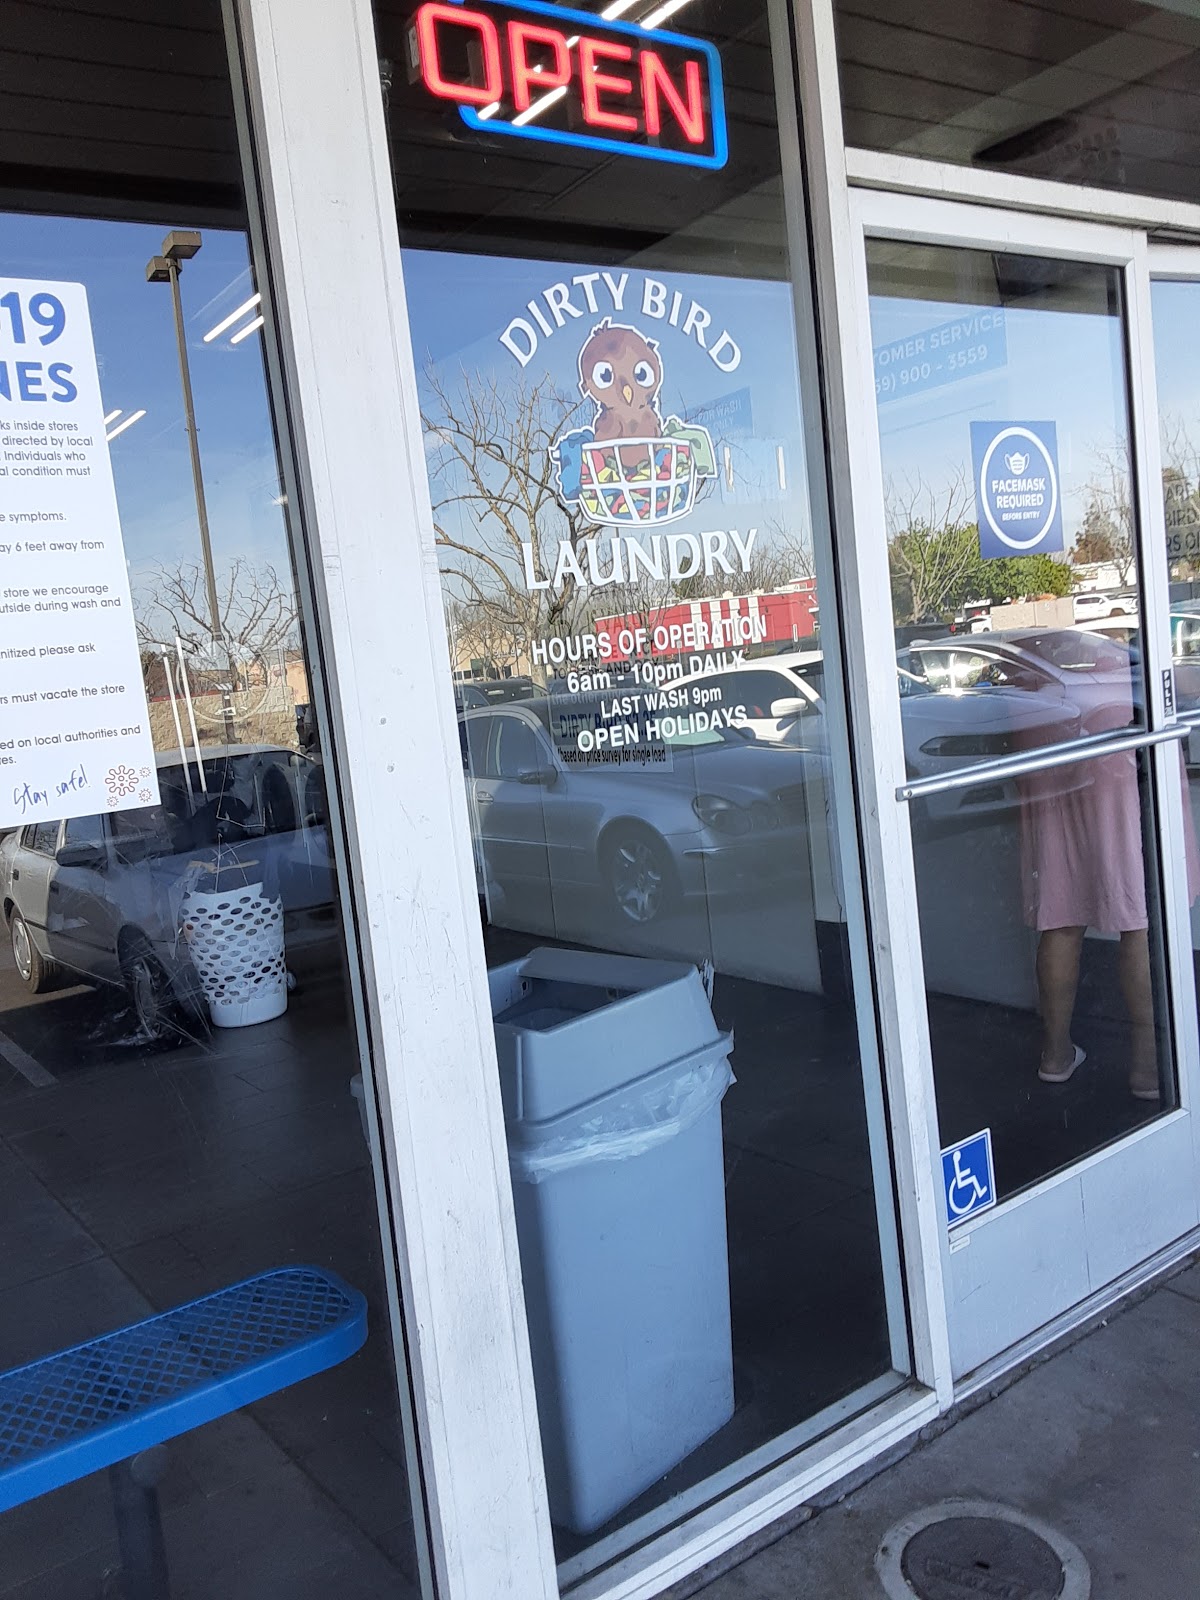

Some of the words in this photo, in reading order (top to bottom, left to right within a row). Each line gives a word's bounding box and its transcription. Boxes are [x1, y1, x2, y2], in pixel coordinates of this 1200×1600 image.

[416, 2, 704, 144] OPEN
[498, 272, 629, 368] DIRTY
[641, 277, 742, 373] BIRD
[899, 362, 931, 385] 900
[948, 344, 988, 370] 3559
[13, 420, 45, 431] inside
[48, 420, 79, 431] stores
[2, 435, 47, 446] directed
[50, 436, 63, 448] by
[66, 436, 93, 446] local
[4, 450, 62, 461] Individuals
[64, 451, 86, 461] who
[12, 466, 63, 476] condition
[66, 466, 91, 476] must
[991, 477, 1046, 494] FACEMASK
[996, 493, 1044, 509] REQUIRED
[9, 511, 67, 524] symptoms.
[15, 542, 22, 552] 6
[25, 541, 46, 551] feet
[49, 542, 77, 553] away
[80, 540, 104, 550] from
[521, 528, 758, 590] LAUNDRY
[3, 588, 29, 598] store
[32, 588, 48, 596] we
[51, 585, 109, 595] encourage
[34, 600, 68, 612] during
[71, 598, 97, 609] wash
[100, 597, 121, 607] and
[531, 632, 612, 666] HOURS
[618, 628, 648, 654] OF
[653, 614, 767, 651] OPERATION
[39, 645, 75, 658] please
[78, 642, 96, 653] ask
[566, 669, 613, 694] 6am
[633, 660, 685, 689] 10pm
[689, 650, 747, 677] DAILY
[11, 691, 38, 703] must
[40, 689, 78, 701] vacate
[81, 686, 98, 697] the
[101, 684, 125, 694] store
[1163, 670, 1172, 707] PULL
[601, 695, 640, 719] LAST
[644, 688, 689, 711] WASH
[692, 684, 722, 707] 9pm
[17, 739, 32, 748] on
[35, 734, 62, 746] local
[64, 728, 118, 742] authorities
[120, 725, 141, 736] and
[577, 725, 640, 753] OPEN
[647, 704, 748, 740] HOLIDAYS
[13, 782, 49, 815] Stay
